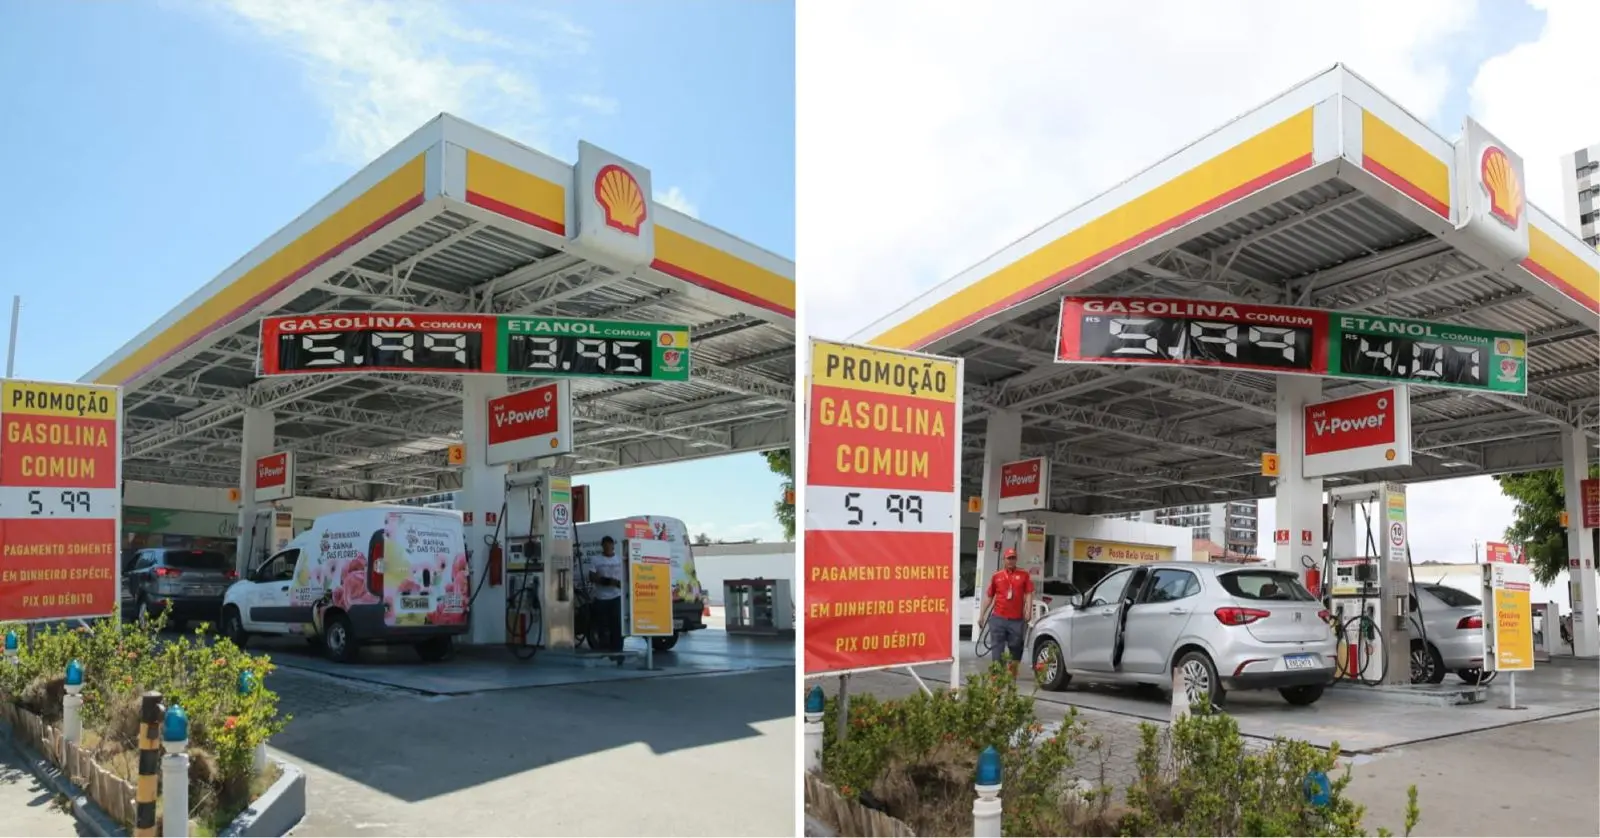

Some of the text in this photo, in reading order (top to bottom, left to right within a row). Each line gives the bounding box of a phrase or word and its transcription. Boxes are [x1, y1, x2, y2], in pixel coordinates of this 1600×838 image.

[279, 317, 482, 331] GASOLINA COMUM
[1083, 300, 1312, 326] GASOLINA COMUM
[508, 320, 651, 337] ETANOL COMUM
[1340, 316, 1488, 344] ETANOL COMUM
[302, 332, 466, 366] 5.99
[1110, 318, 1296, 363] 5.99
[528, 337, 642, 373] 3.95
[1360, 338, 1480, 380] 4.07
[827, 354, 946, 394] PROMOÇÃO
[13, 389, 108, 416] PROMOÇÃO
[495, 406, 550, 428] V-Power
[820, 397, 945, 437] GASOLINA
[1314, 413, 1386, 436] V-Power
[8, 421, 108, 447] GASOLINA
[455, 448, 462, 460] 3
[836, 444, 928, 478] COMUM
[1268, 458, 1276, 470] 3
[22, 455, 95, 479] COMUM
[259, 466, 284, 478] V-Power
[1005, 474, 1036, 486] V-Power
[28, 490, 90, 515] 5.99
[557, 508, 565, 516] 10
[845, 492, 923, 525] 5.99
[1394, 527, 1401, 536] 10
[4, 543, 112, 556] PAGAMENTO SOMENTE
[1108, 548, 1124, 558] Posto
[3, 566, 112, 582] EM DINHEIRO ESPÉCIE,
[812, 565, 949, 582] PAGAMENTO SOMENTE
[23, 592, 93, 607] PIX OU DÉBITO
[810, 595, 949, 618] EM DINHEIRO ESPÉCIE,
[836, 630, 925, 653] PIX OU DÉBITO
